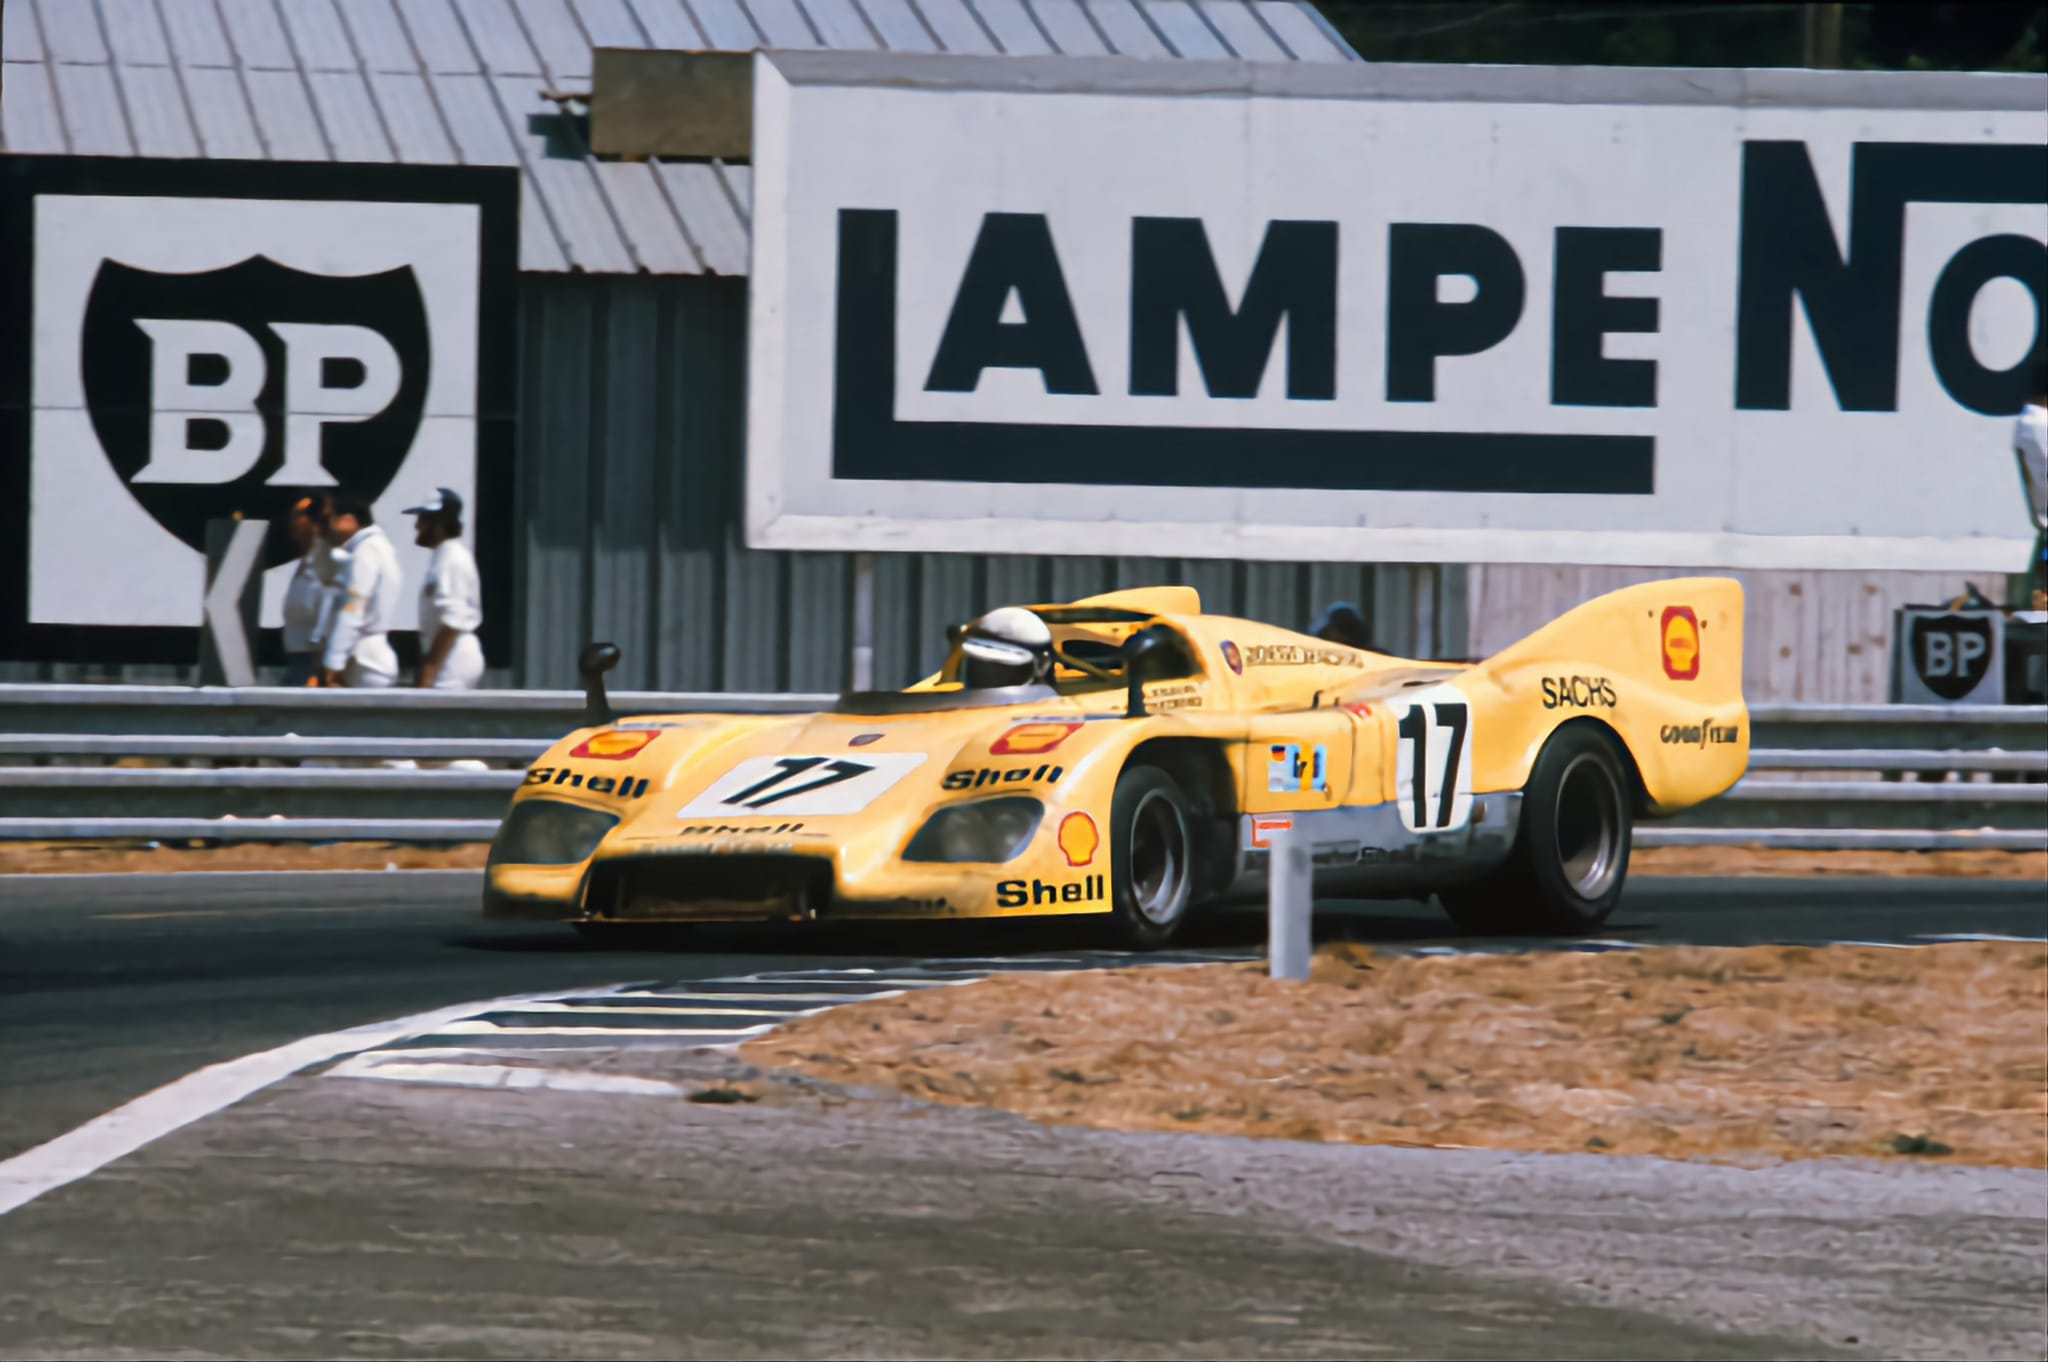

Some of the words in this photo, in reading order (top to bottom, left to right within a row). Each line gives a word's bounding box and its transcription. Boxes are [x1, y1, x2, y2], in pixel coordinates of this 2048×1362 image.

[831, 207, 1662, 495] LAMPE
[130, 318, 403, 487] BP
[1923, 631, 1986, 678] BP
[1541, 675, 1617, 709] SACHS
[526, 767, 649, 799] Shell
[942, 764, 1064, 790] Shell
[1399, 702, 1468, 828] 17
[996, 874, 1104, 908] Shell
